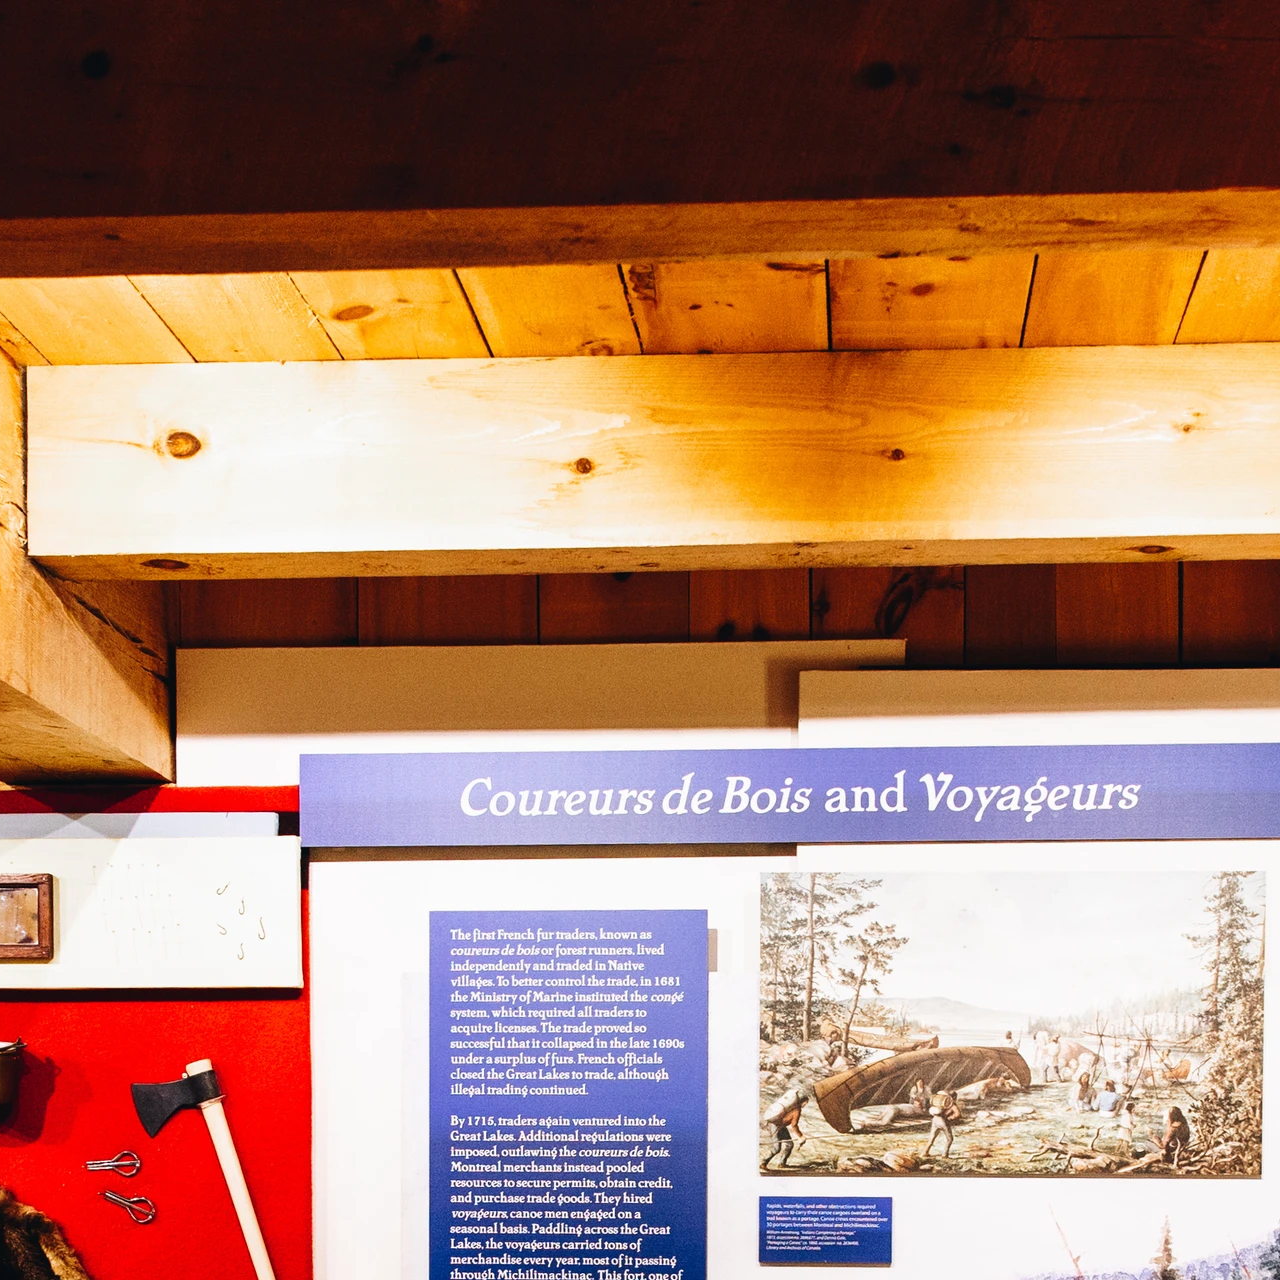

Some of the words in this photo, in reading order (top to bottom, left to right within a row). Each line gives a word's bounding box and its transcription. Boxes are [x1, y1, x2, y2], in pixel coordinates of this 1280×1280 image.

[460, 777, 656, 818] Coureurs
[661, 771, 713, 815] de
[718, 775, 813, 814] Bois
[825, 770, 908, 813] and
[919, 771, 1142, 822] Voyageurs
[450, 928, 471, 940] The
[473, 928, 496, 943] first
[497, 928, 535, 940] French
[537, 928, 555, 943] fur
[555, 927, 598, 940] traders,
[599, 927, 638, 940] known
[639, 931, 652, 939] as
[450, 947, 500, 956] coureurs
[501, 944, 515, 956] de
[516, 943, 540, 956] bois
[541, 947, 554, 956] or
[555, 943, 587, 958] forest
[588, 947, 635, 956] runners,
[637, 943, 665, 955] lived
[450, 959, 531, 974] independently
[532, 959, 555, 971] and
[556, 959, 593, 971] traded
[594, 960, 606, 971] in
[607, 959, 644, 971] Native
[450, 974, 495, 990] villages.
[496, 975, 510, 987] To
[511, 975, 544, 987] better
[545, 974, 586, 987] control
[587, 974, 605, 987] the
[606, 975, 639, 987] trade,
[640, 976, 652, 987] in
[655, 976, 680, 986] 1681
[450, 990, 468, 1002] the
[470, 991, 518, 1005] Ministry
[519, 990, 532, 1005] of
[532, 991, 573, 1002] Marine
[575, 990, 628, 1002] instituted
[630, 990, 648, 1002] the
[650, 991, 684, 1005] congé
